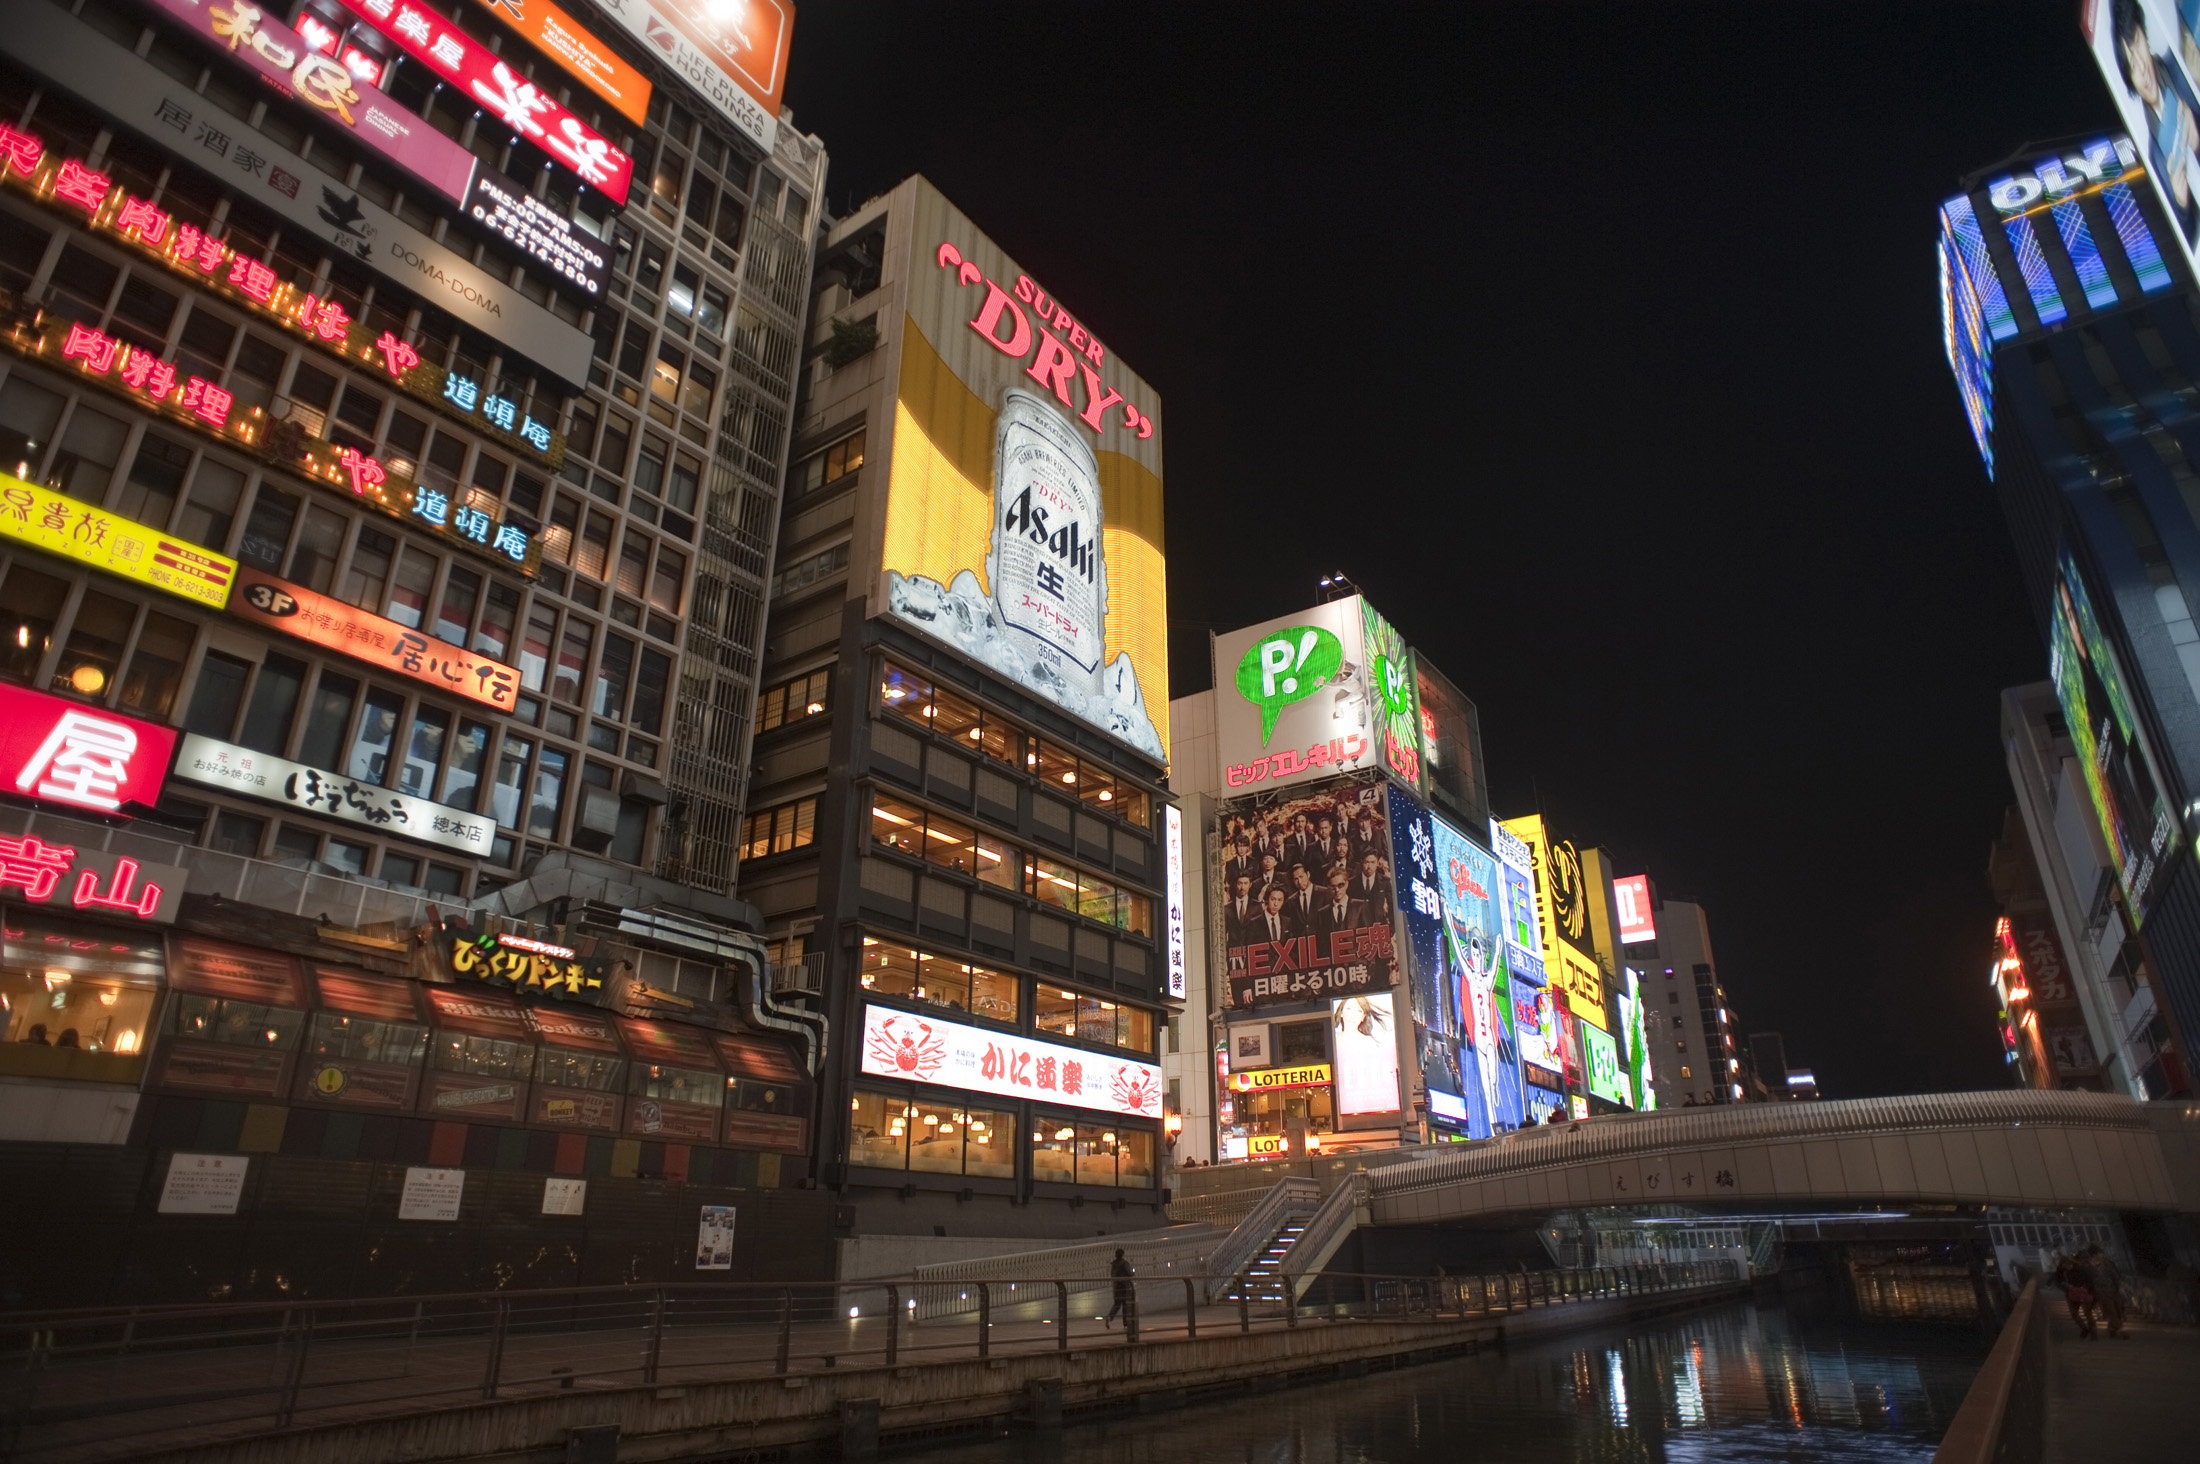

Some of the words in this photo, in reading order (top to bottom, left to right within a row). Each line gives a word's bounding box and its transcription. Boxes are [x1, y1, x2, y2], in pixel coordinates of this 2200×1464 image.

[676, 56, 764, 138] HOLDINGS
[679, 42, 716, 80] LIFE
[719, 78, 766, 127] PLAZA
[154, 97, 265, 178] 居酒家
[365, 116, 395, 138] DINING
[366, 110, 399, 135] CASUAL
[368, 105, 410, 136] JAPANESE
[472, 205, 598, 293] 06-6214-8800
[391, 242, 501, 319] DOMA-DOMA
[1014, 273, 1105, 368] SUPER
[1005, 485, 1095, 585] Asahi
[147, 566, 173, 585] PHONE
[173, 576, 225, 604] 06-6213-3003
[250, 586, 294, 614] 3F
[1036, 560, 1065, 602] 生
[1021, 593, 1079, 639] スーパードライ
[391, 631, 513, 703] 居心伝
[1260, 630, 1319, 698] P!
[15, 710, 139, 811] 屋
[1226, 735, 1368, 788] ピップエレキバン
[0, 836, 163, 918] 青山
[1411, 876, 1441, 921] 雪印
[1450, 857, 1490, 900] Glico
[452, 936, 602, 995] びっくりドンキー
[1229, 956, 1247, 970] TV
[1254, 963, 1368, 997] 日曜よる10時
[2025, 928, 2068, 1000] スポタカ
[1254, 1069, 1326, 1087] LOTTERIA
[1615, 1167, 1736, 1193] えびす橋
